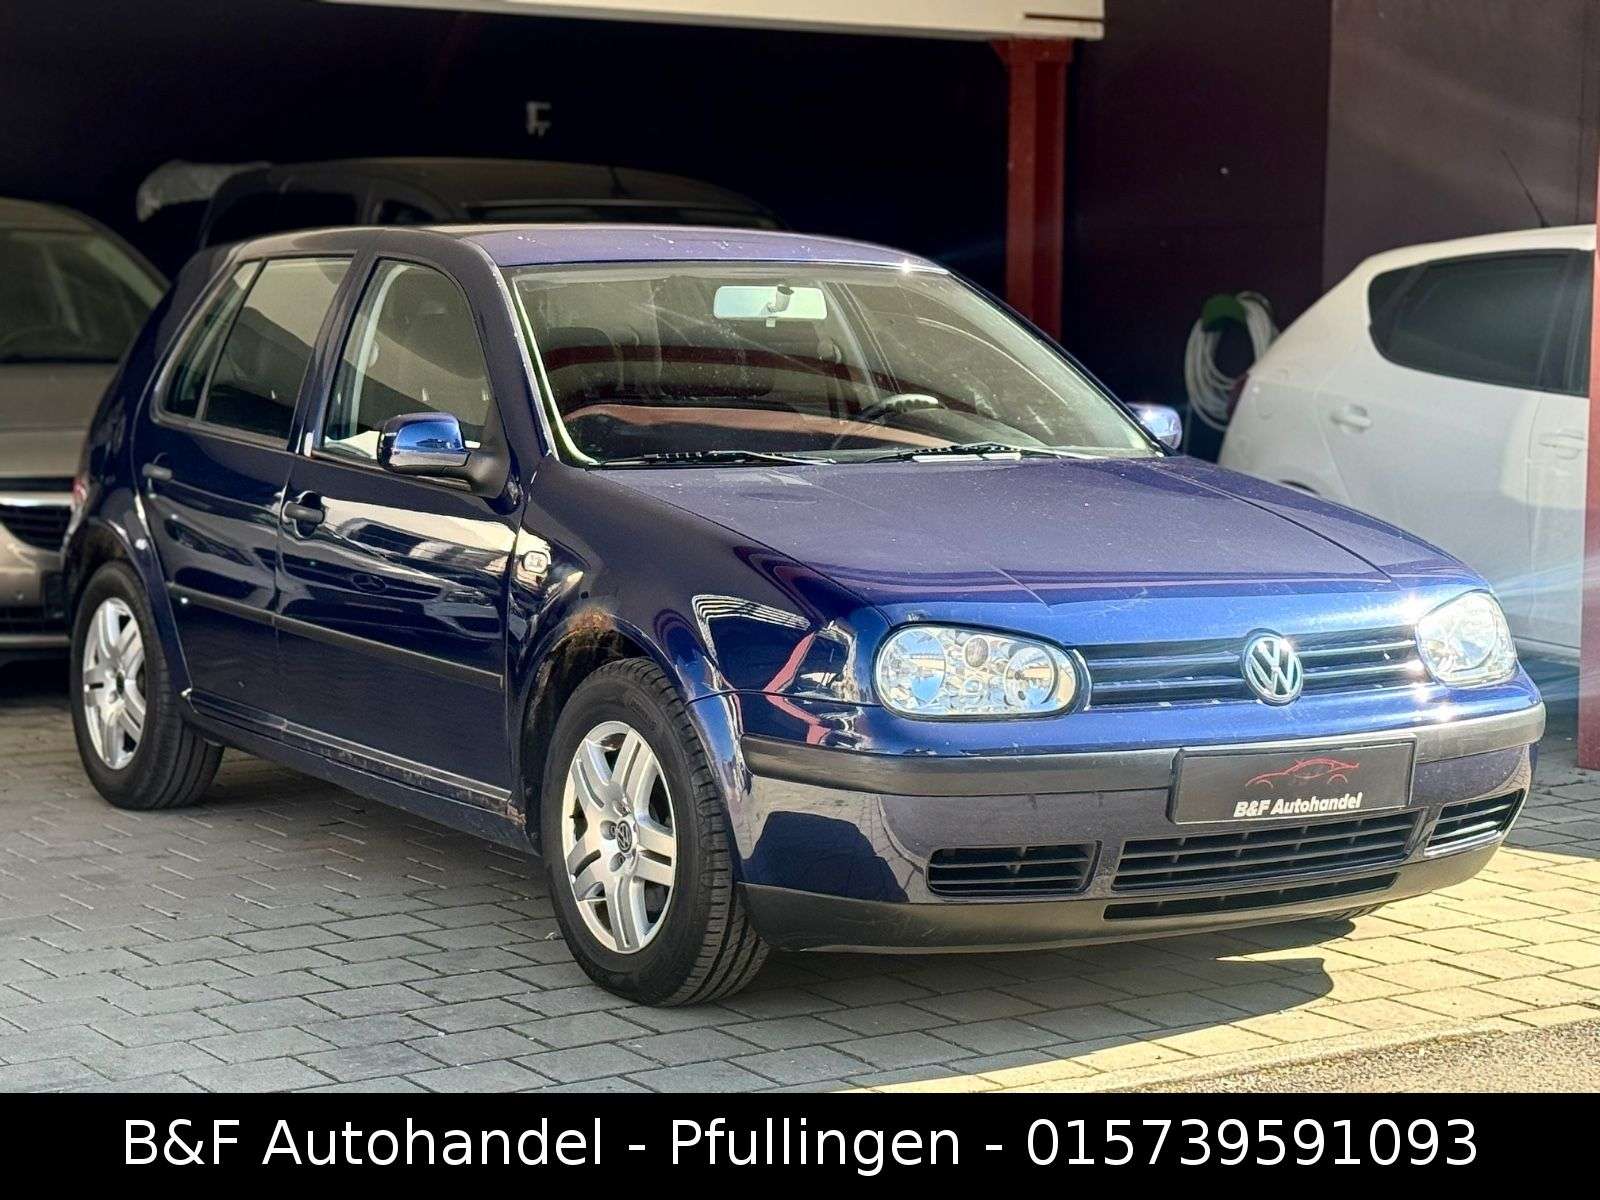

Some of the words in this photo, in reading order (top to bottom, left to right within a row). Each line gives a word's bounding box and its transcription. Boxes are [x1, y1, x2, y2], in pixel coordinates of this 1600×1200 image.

[1246, 633, 1303, 703] VW
[1233, 800, 1271, 818] B&F
[1271, 792, 1363, 816] Autohandel
